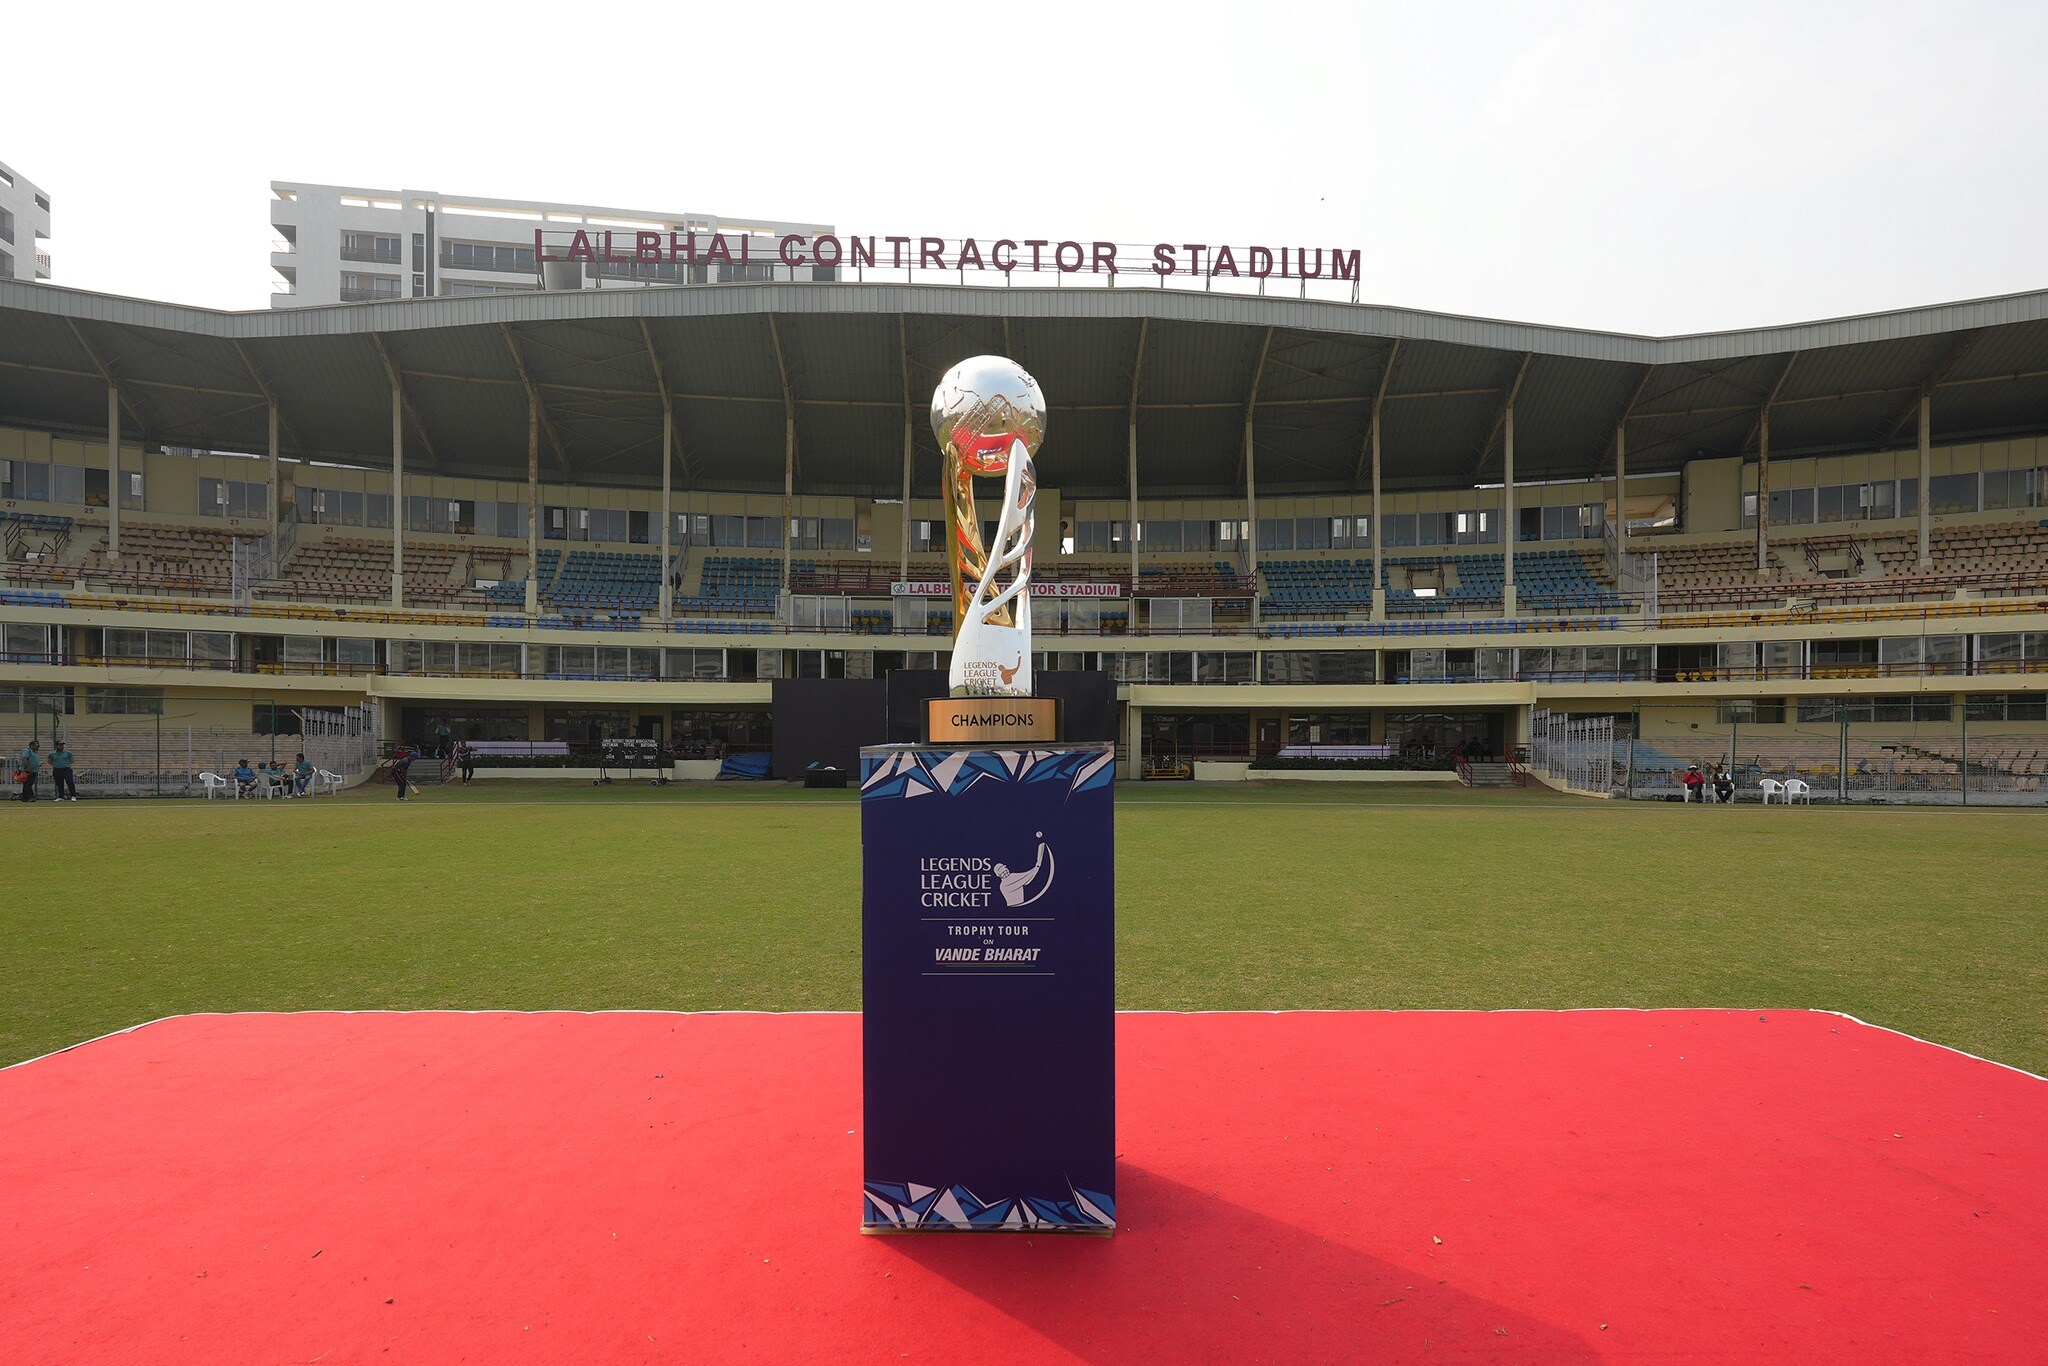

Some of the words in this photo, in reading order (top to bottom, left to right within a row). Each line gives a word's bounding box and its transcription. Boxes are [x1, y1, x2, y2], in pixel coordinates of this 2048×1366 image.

[534, 228, 749, 266] LALBHAI
[779, 233, 1119, 274] CONTRACTOR
[1152, 243, 1361, 281] STADIUM
[909, 584, 951, 594] LALBH
[1060, 585, 1117, 595] STADIUM
[963, 661, 997, 669] LEGENDS
[963, 669, 997, 678] LEAGUE
[963, 677, 997, 686] CRICKET
[951, 713, 1034, 727] CHAMPIONS
[921, 857, 992, 872] LEGENDS
[921, 874, 992, 890] LEAGUE
[921, 892, 992, 908] CRICKET
[948, 926, 994, 936] TROPHY
[998, 926, 1029, 936] TOUR
[935, 948, 982, 961] VANDE
[984, 948, 1041, 961] BHARAT
